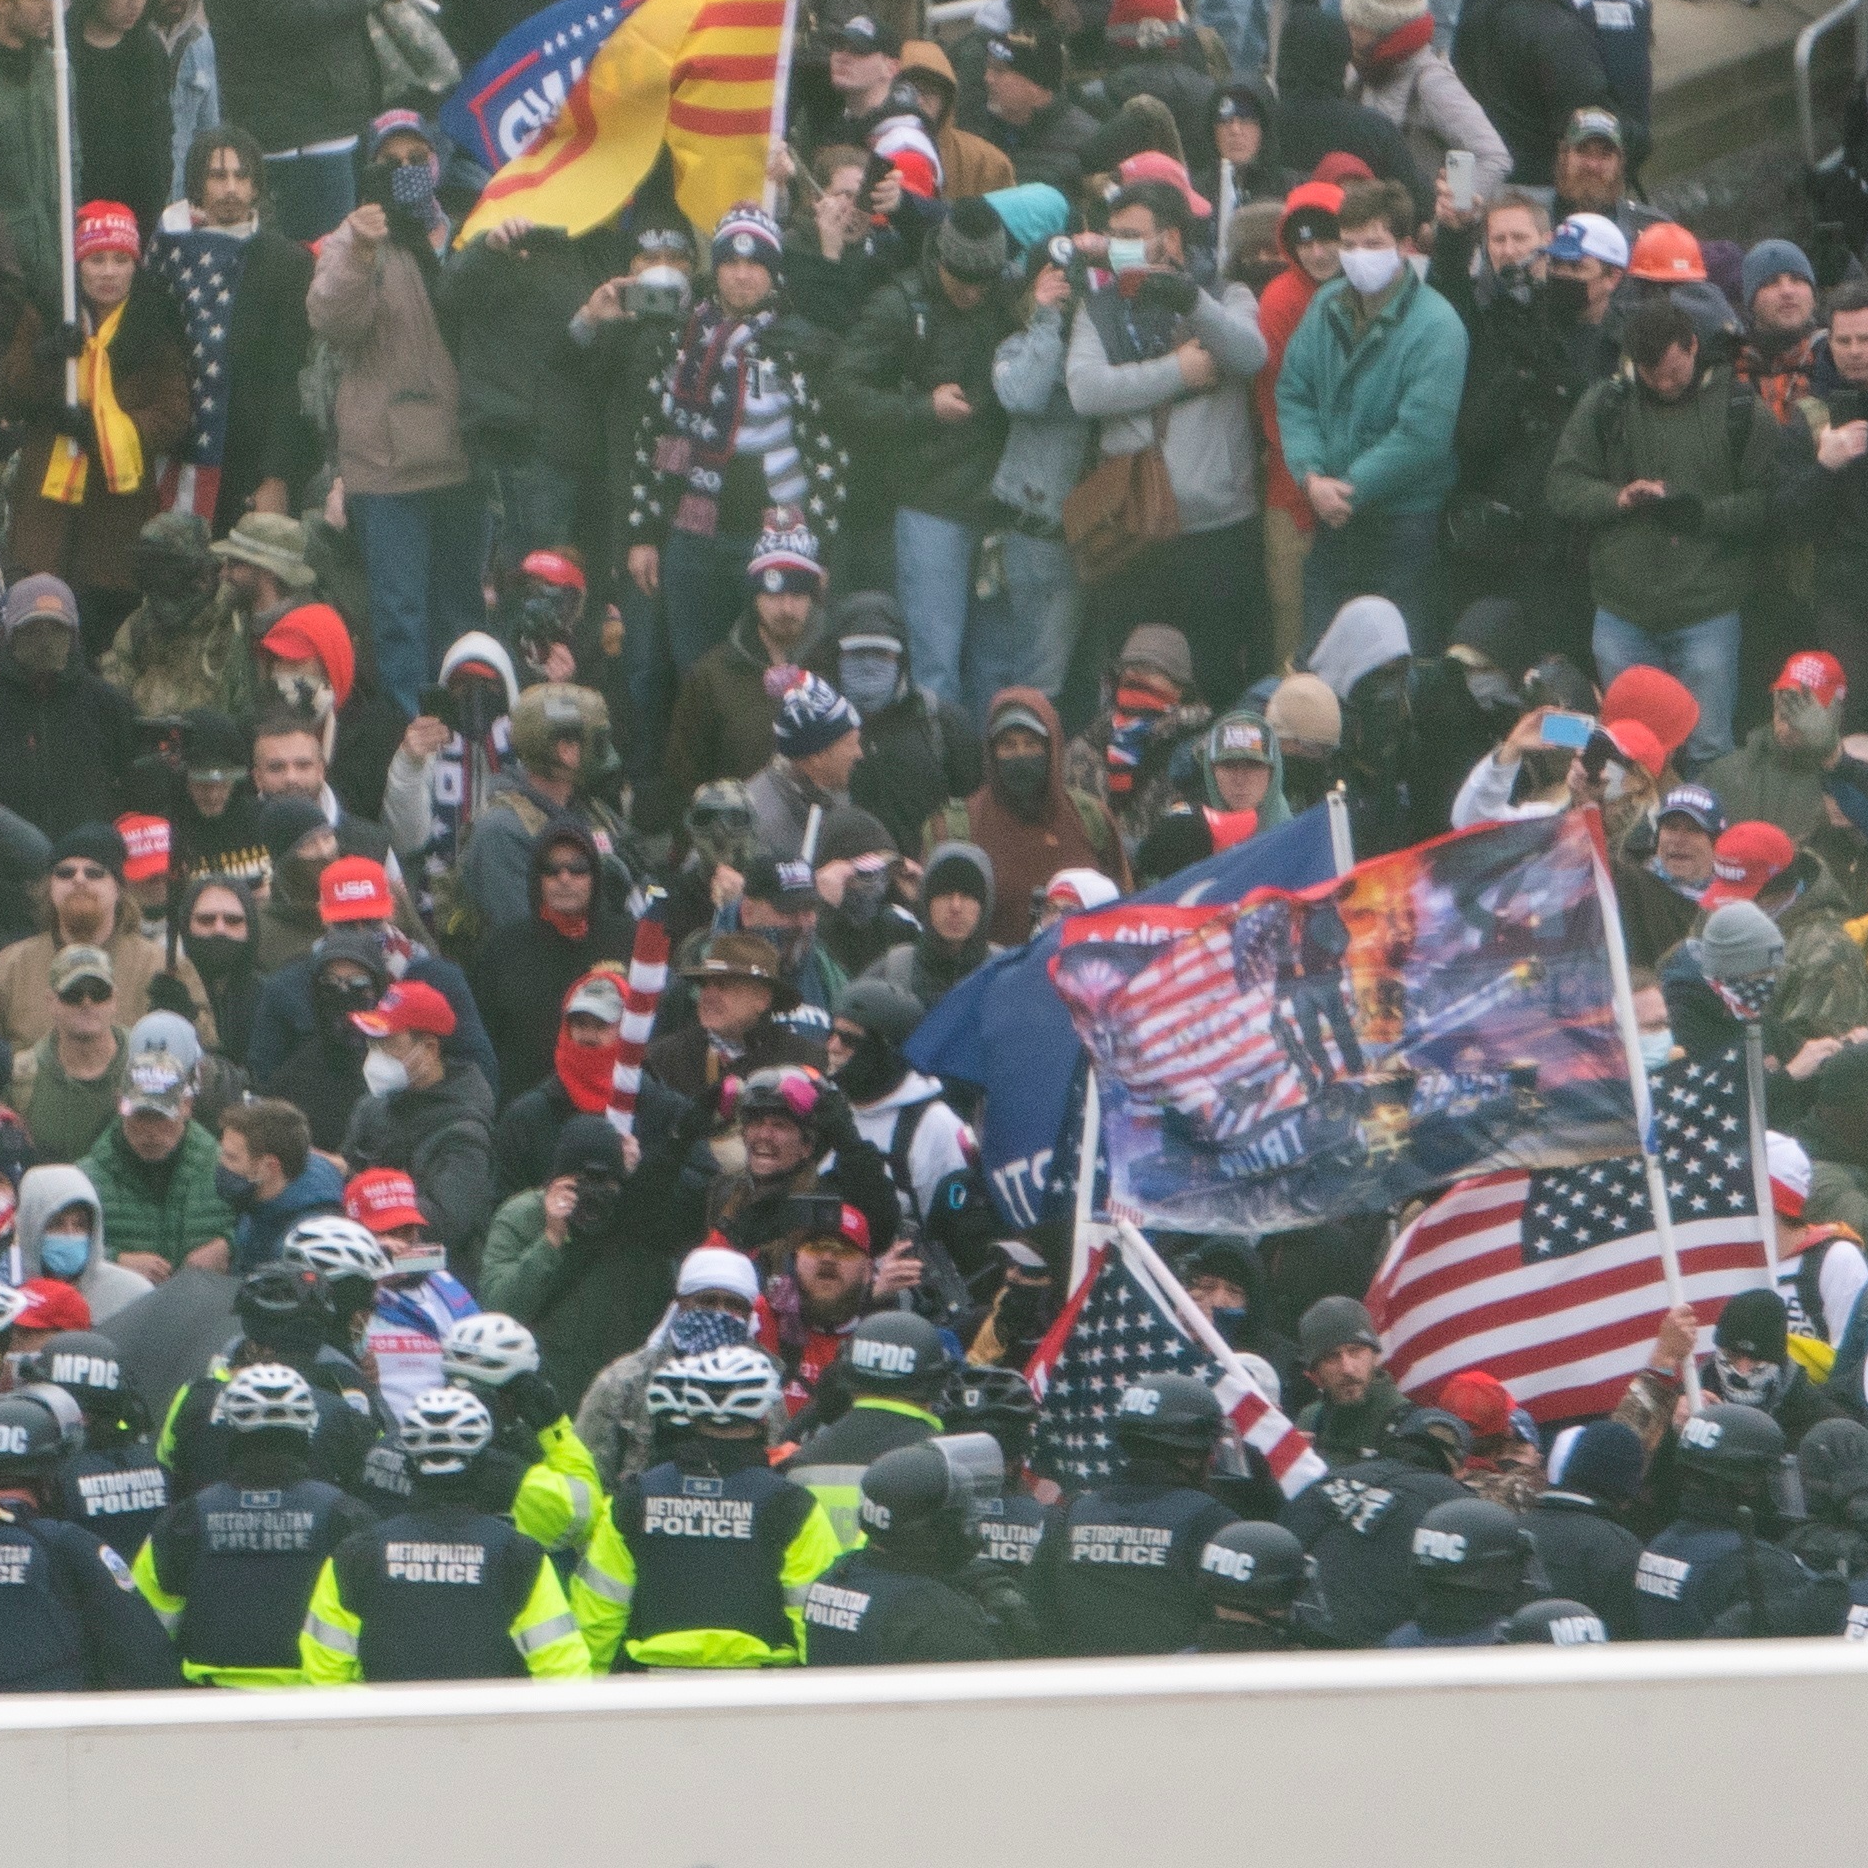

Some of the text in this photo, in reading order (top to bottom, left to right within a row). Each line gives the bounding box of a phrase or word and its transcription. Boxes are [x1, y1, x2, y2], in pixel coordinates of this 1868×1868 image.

[334, 880, 375, 900] USA
[52, 1353, 118, 1389] MPDC
[84, 1486, 169, 1516] POLICE
[645, 1497, 753, 1523] METROPOLITAN
[645, 1516, 753, 1539] POLICE
[1071, 1524, 1173, 1549] METROPOLITAN
[385, 1542, 485, 1566] METROPOLITAN
[1071, 1543, 1167, 1567] POLICE
[385, 1563, 483, 1585] POLICE
